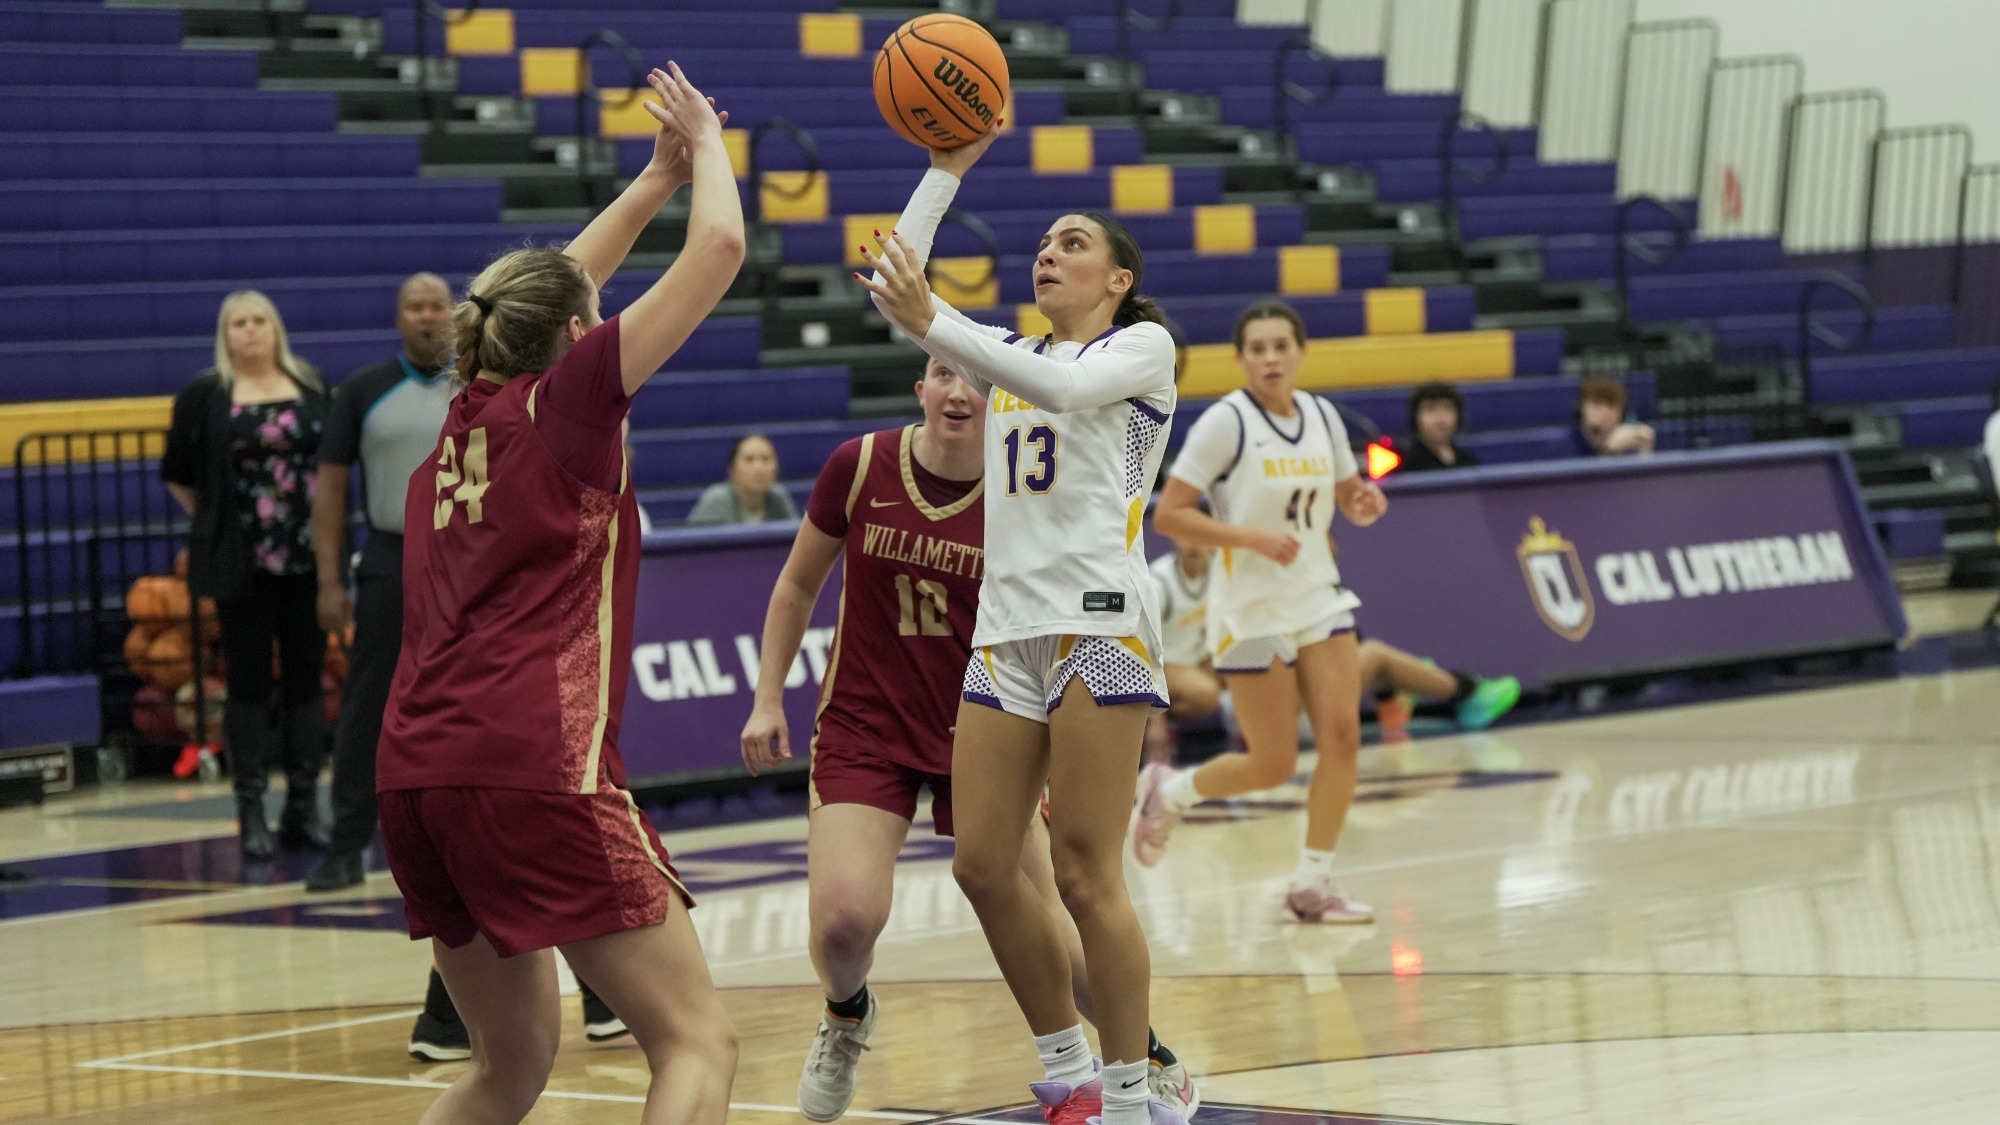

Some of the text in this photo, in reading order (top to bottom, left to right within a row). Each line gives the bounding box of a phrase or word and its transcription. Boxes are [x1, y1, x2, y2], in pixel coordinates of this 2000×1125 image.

[934, 56, 994, 126] Wilson
[433, 426, 491, 530] 24
[1003, 422, 1058, 497] 13
[1285, 488, 1317, 531] 41
[862, 522, 985, 581] WILLAMETT
[1596, 530, 1853, 606] CAL LUTHERAN
[894, 574, 954, 636] 12
[1112, 597, 1120, 606] M
[632, 637, 737, 702] CAL
